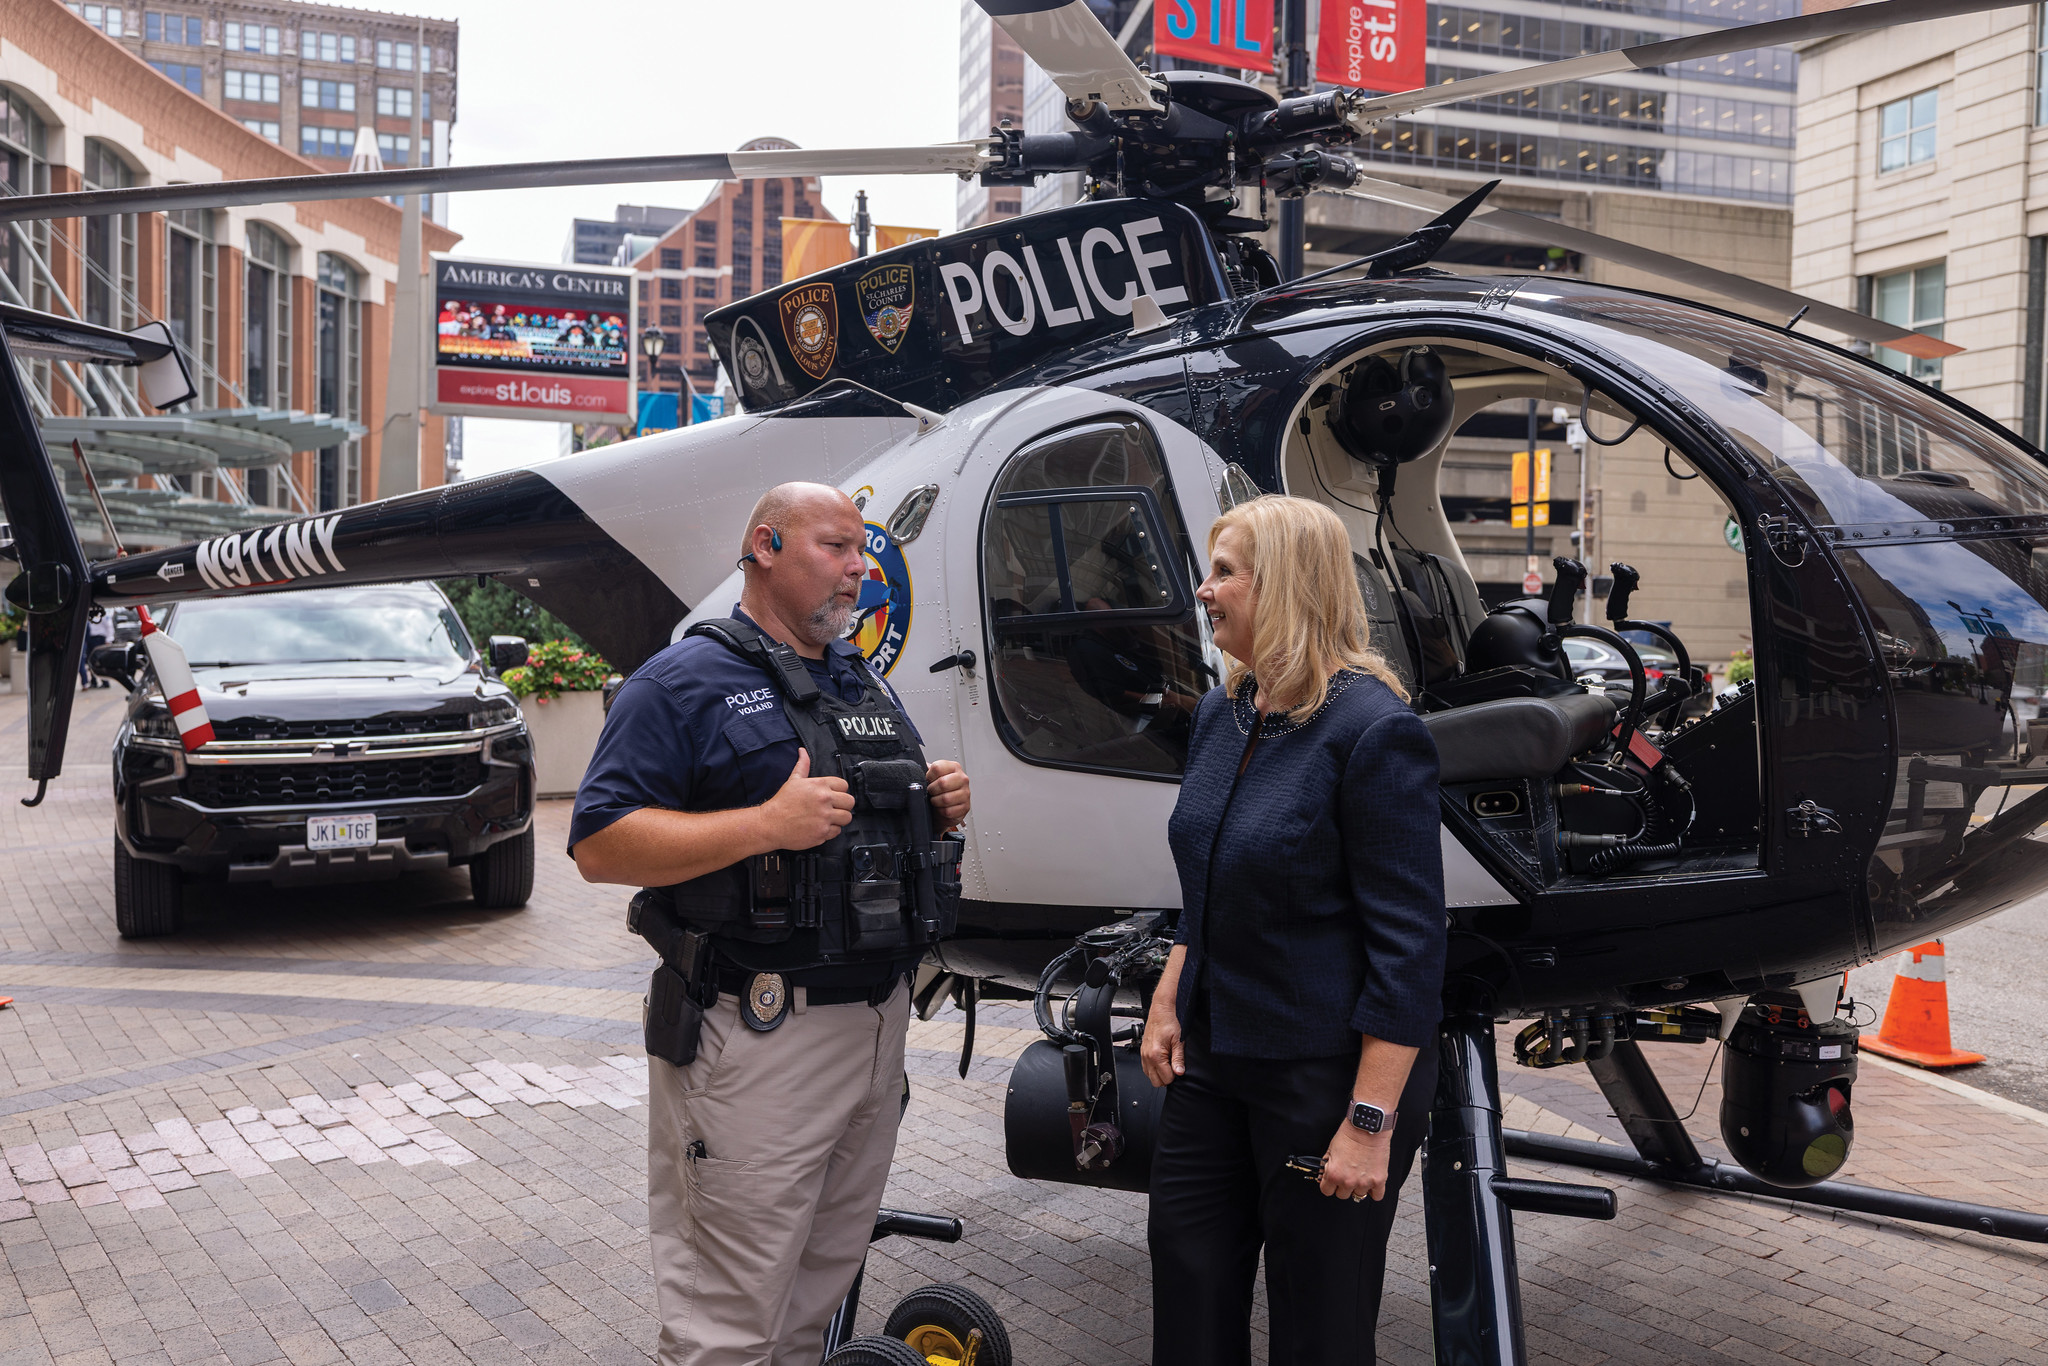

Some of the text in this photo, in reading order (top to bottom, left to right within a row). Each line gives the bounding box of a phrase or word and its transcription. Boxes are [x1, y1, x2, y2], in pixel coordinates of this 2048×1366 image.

[1347, 6, 1364, 83] explore
[443, 265, 626, 296] AMERICA'S CENTER
[860, 269, 909, 295] POLICE
[939, 216, 1189, 344] POLICE
[784, 288, 830, 315] POLICE
[868, 292, 904, 310] COUNTY
[799, 354, 818, 371] LOUIS
[819, 334, 835, 367] COUNTY
[196, 514, 346, 590] N911NY
[163, 565, 184, 577] DANGER
[725, 687, 774, 709] POLICE
[738, 701, 774, 716] VOLAND
[838, 716, 896, 737] POLICE
